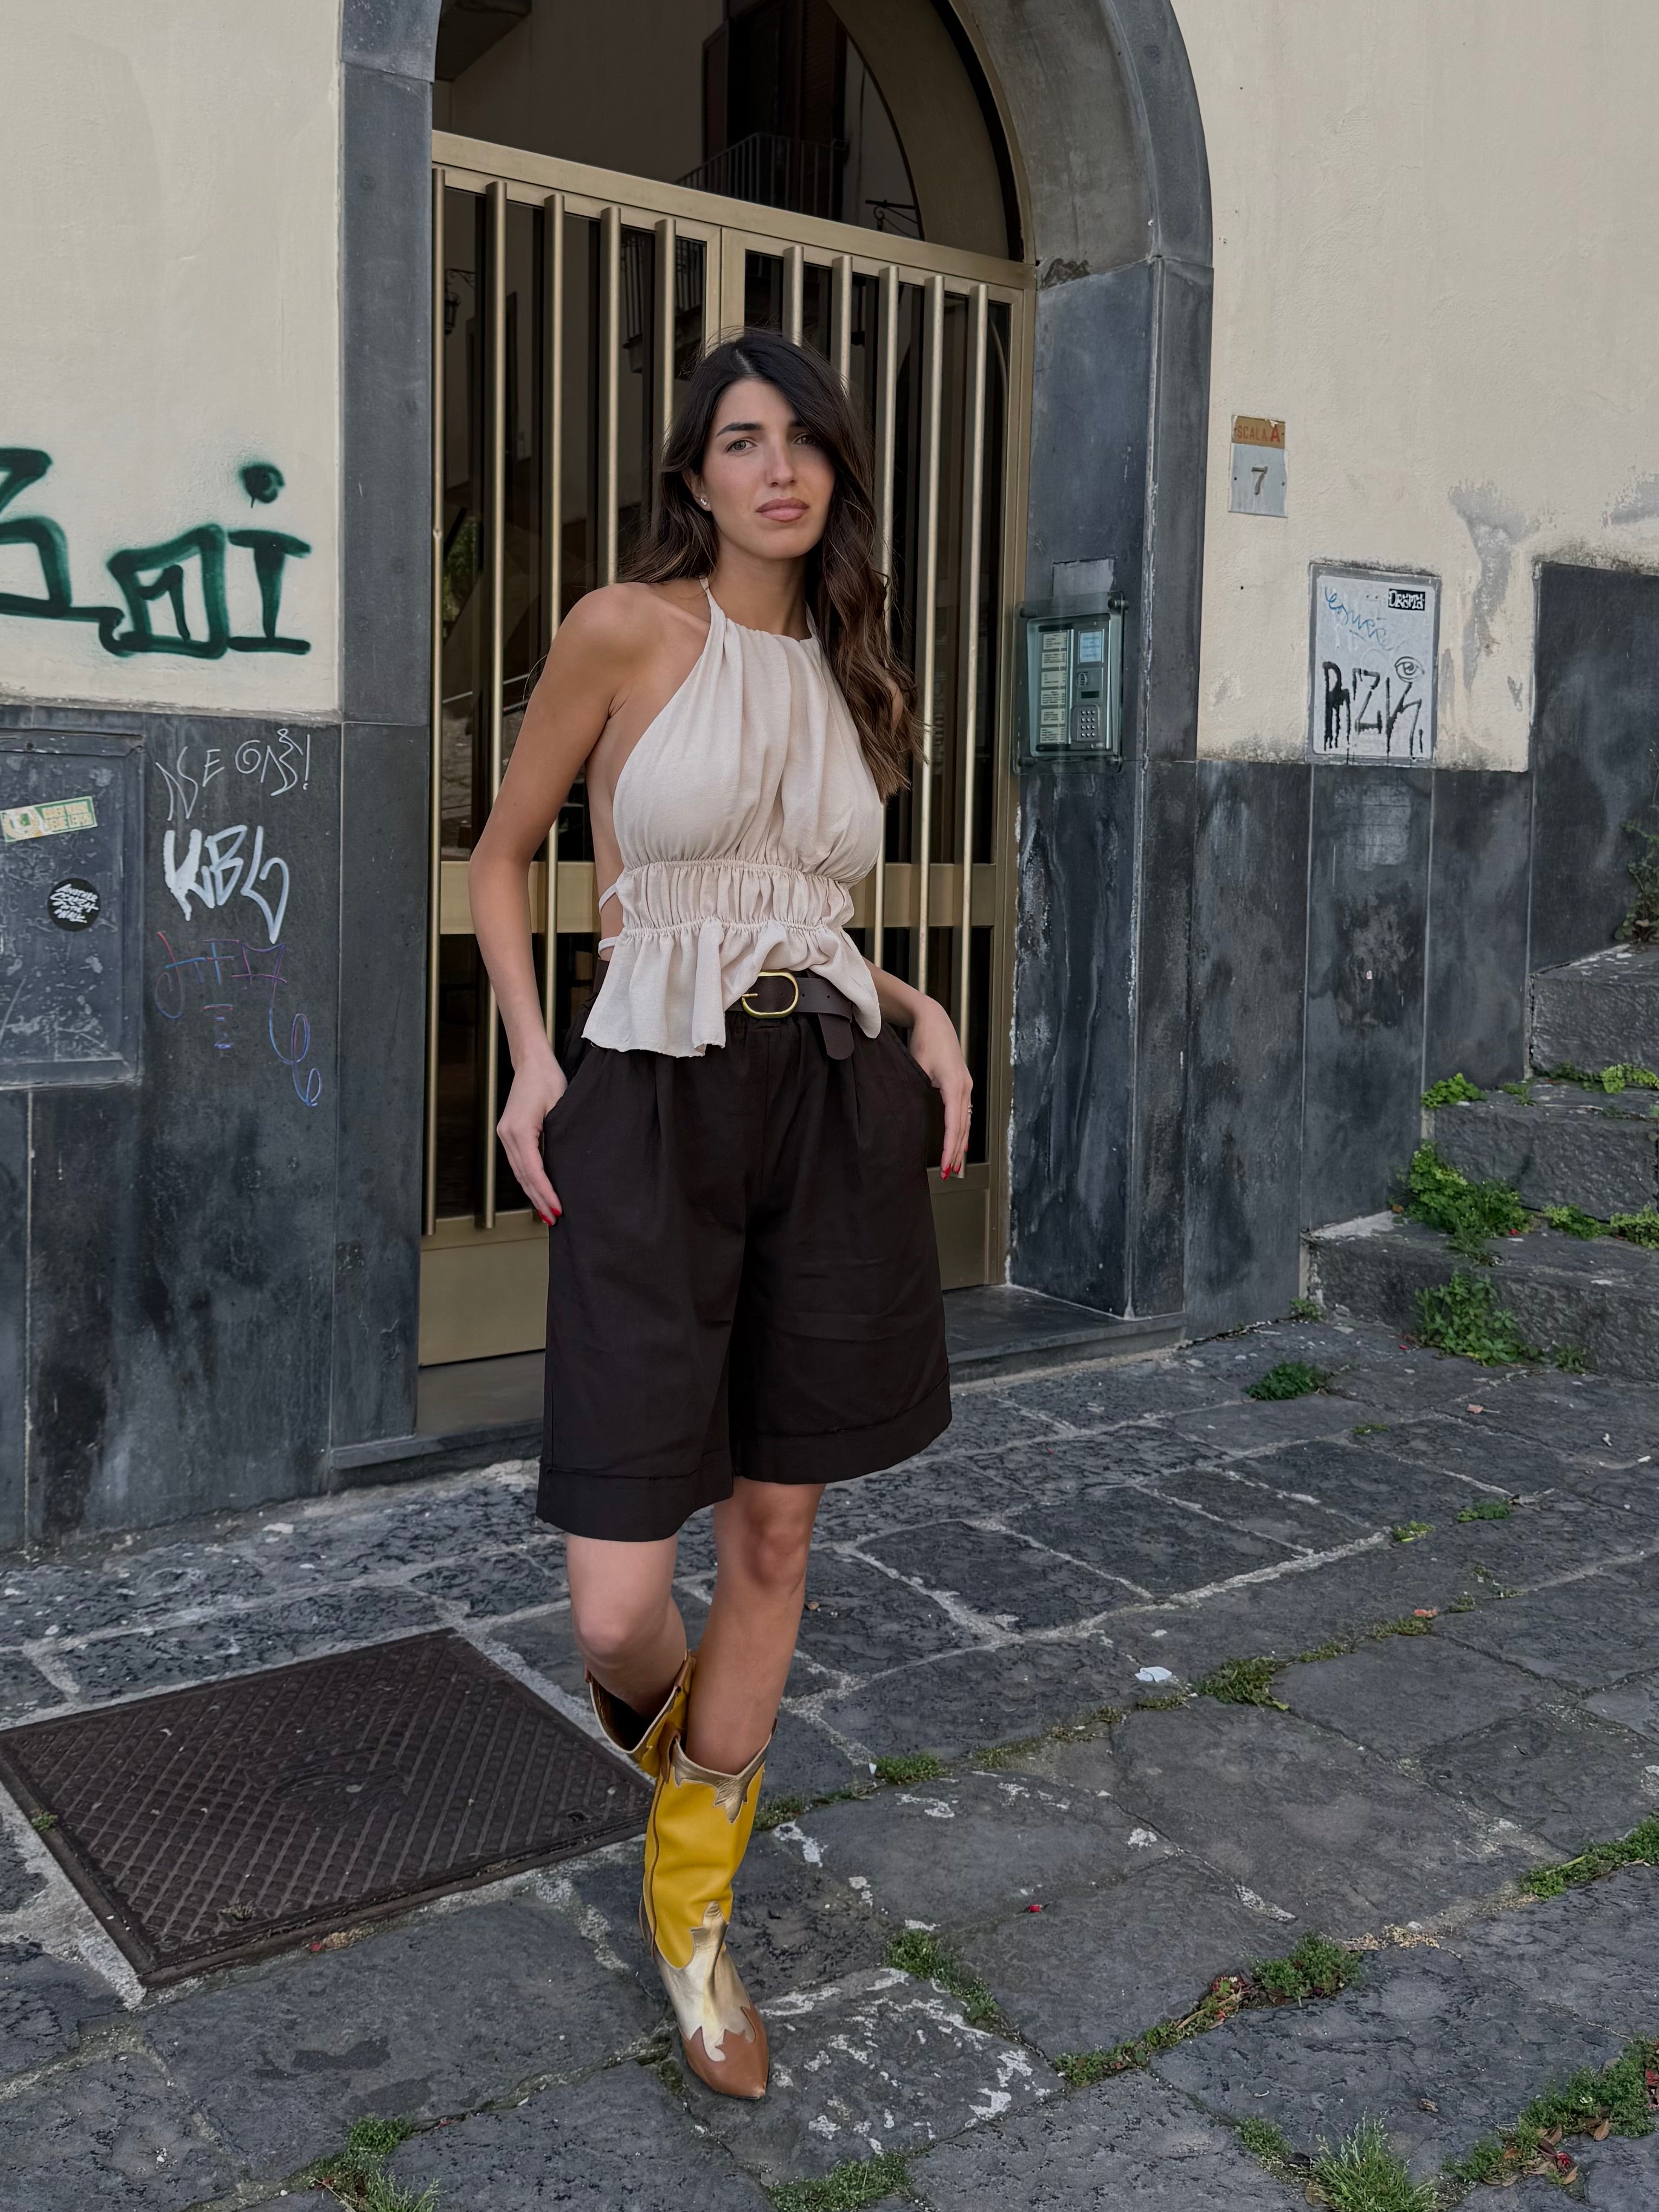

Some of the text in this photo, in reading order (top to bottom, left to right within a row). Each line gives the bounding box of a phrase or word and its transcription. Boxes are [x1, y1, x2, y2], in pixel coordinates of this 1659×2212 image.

[1236, 423, 1281, 443] SCALA A
[1251, 466, 1268, 496] 7
